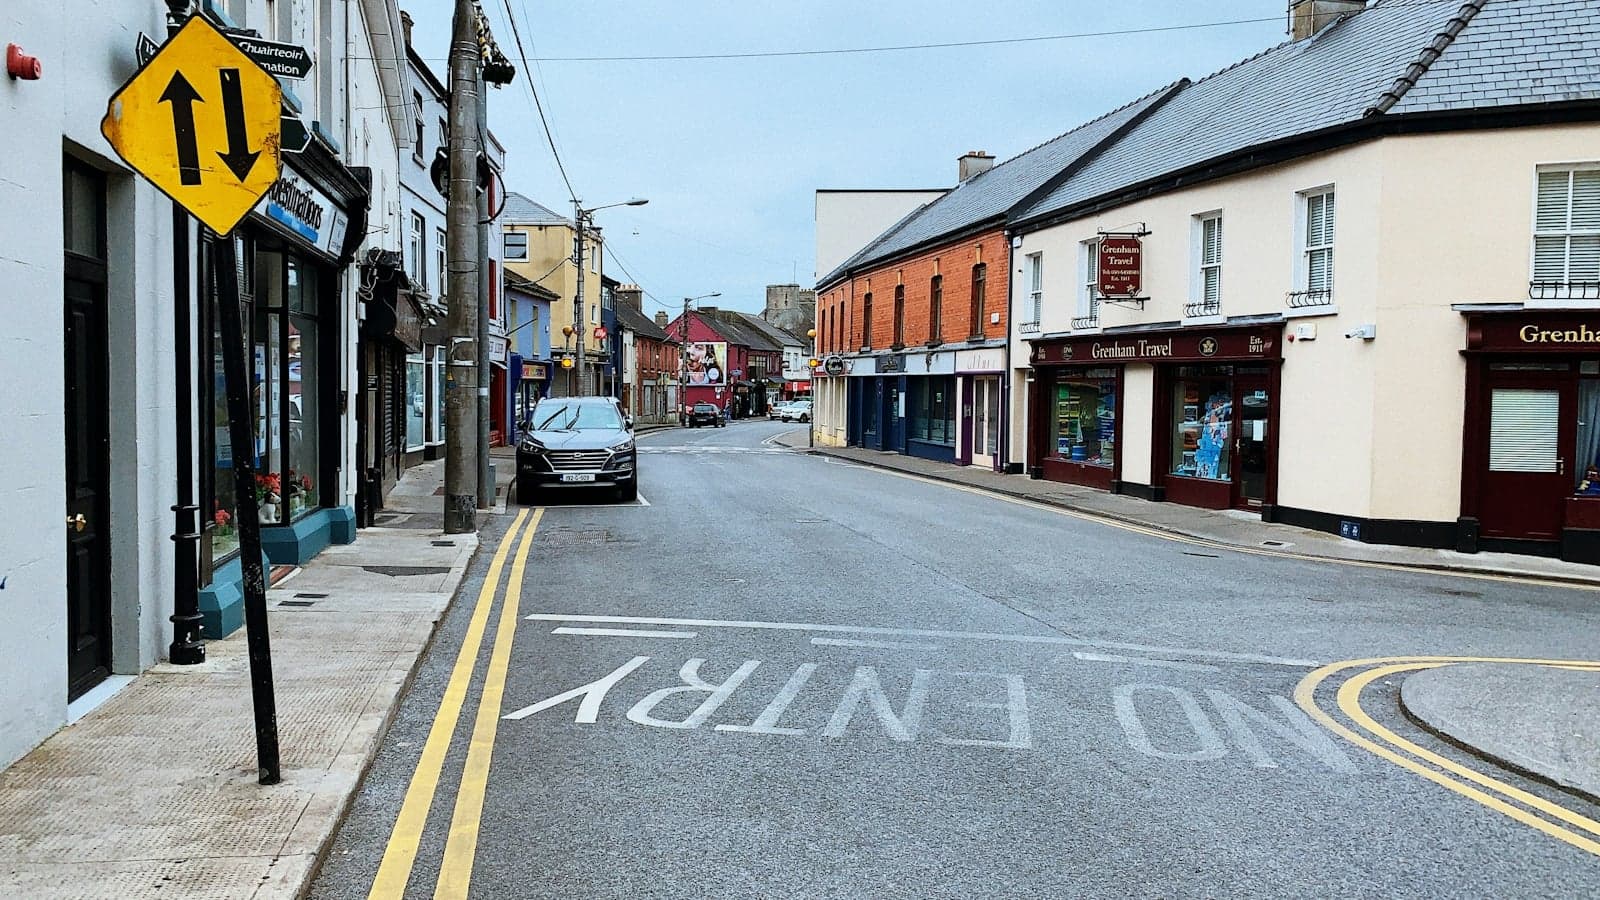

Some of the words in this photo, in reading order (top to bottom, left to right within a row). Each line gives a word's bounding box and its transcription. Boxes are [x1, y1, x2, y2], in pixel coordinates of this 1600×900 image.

[260, 62, 299, 75] mation
[1102, 245, 1139, 254] Grenham
[1108, 256, 1133, 265] Travel
[1250, 335, 1263, 344] Est.
[1091, 341, 1136, 359] Grenham
[1138, 336, 1173, 357] Travel
[1249, 345, 1263, 353] 1911
[499, 655, 1034, 751] ENTRY
[1112, 682, 1360, 776] NO
